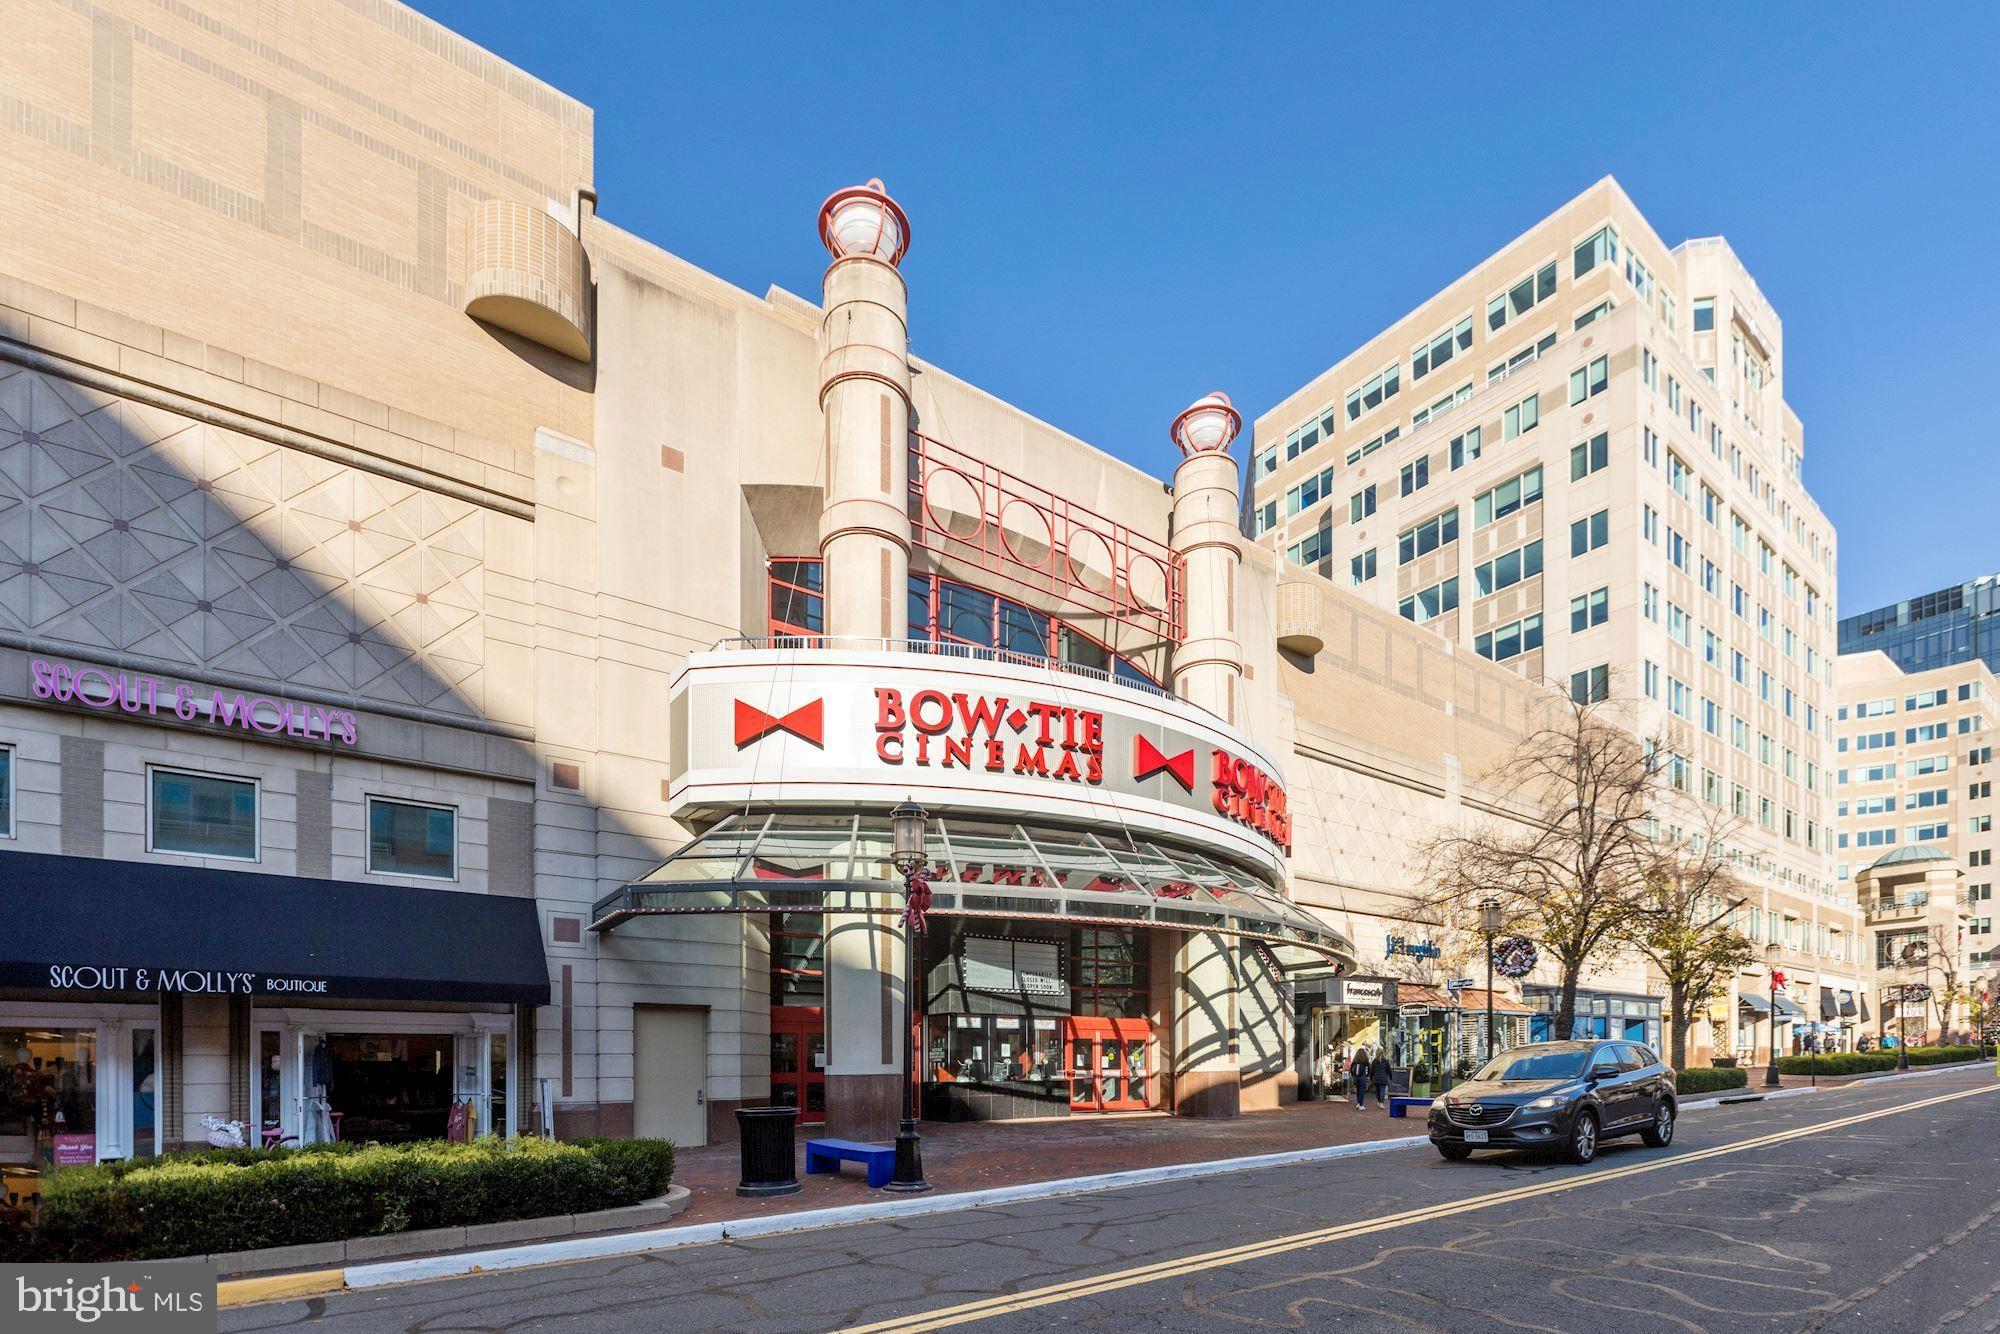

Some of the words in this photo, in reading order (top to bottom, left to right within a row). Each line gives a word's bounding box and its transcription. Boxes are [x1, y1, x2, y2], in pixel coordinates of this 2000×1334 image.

[32, 658, 165, 715] SCOUT
[175, 683, 198, 720] &
[209, 690, 358, 745] MOLLY'S
[874, 687, 1009, 740] BOW
[1027, 701, 1103, 755] TIE
[876, 732, 1103, 786] CINEMAS
[50, 965, 128, 990] SCOUT
[136, 968, 150, 990] &
[157, 970, 253, 993] MOLLY'S
[266, 978, 328, 993] BOUTIQUE
[1021, 970, 1052, 978] TEMPORARILY
